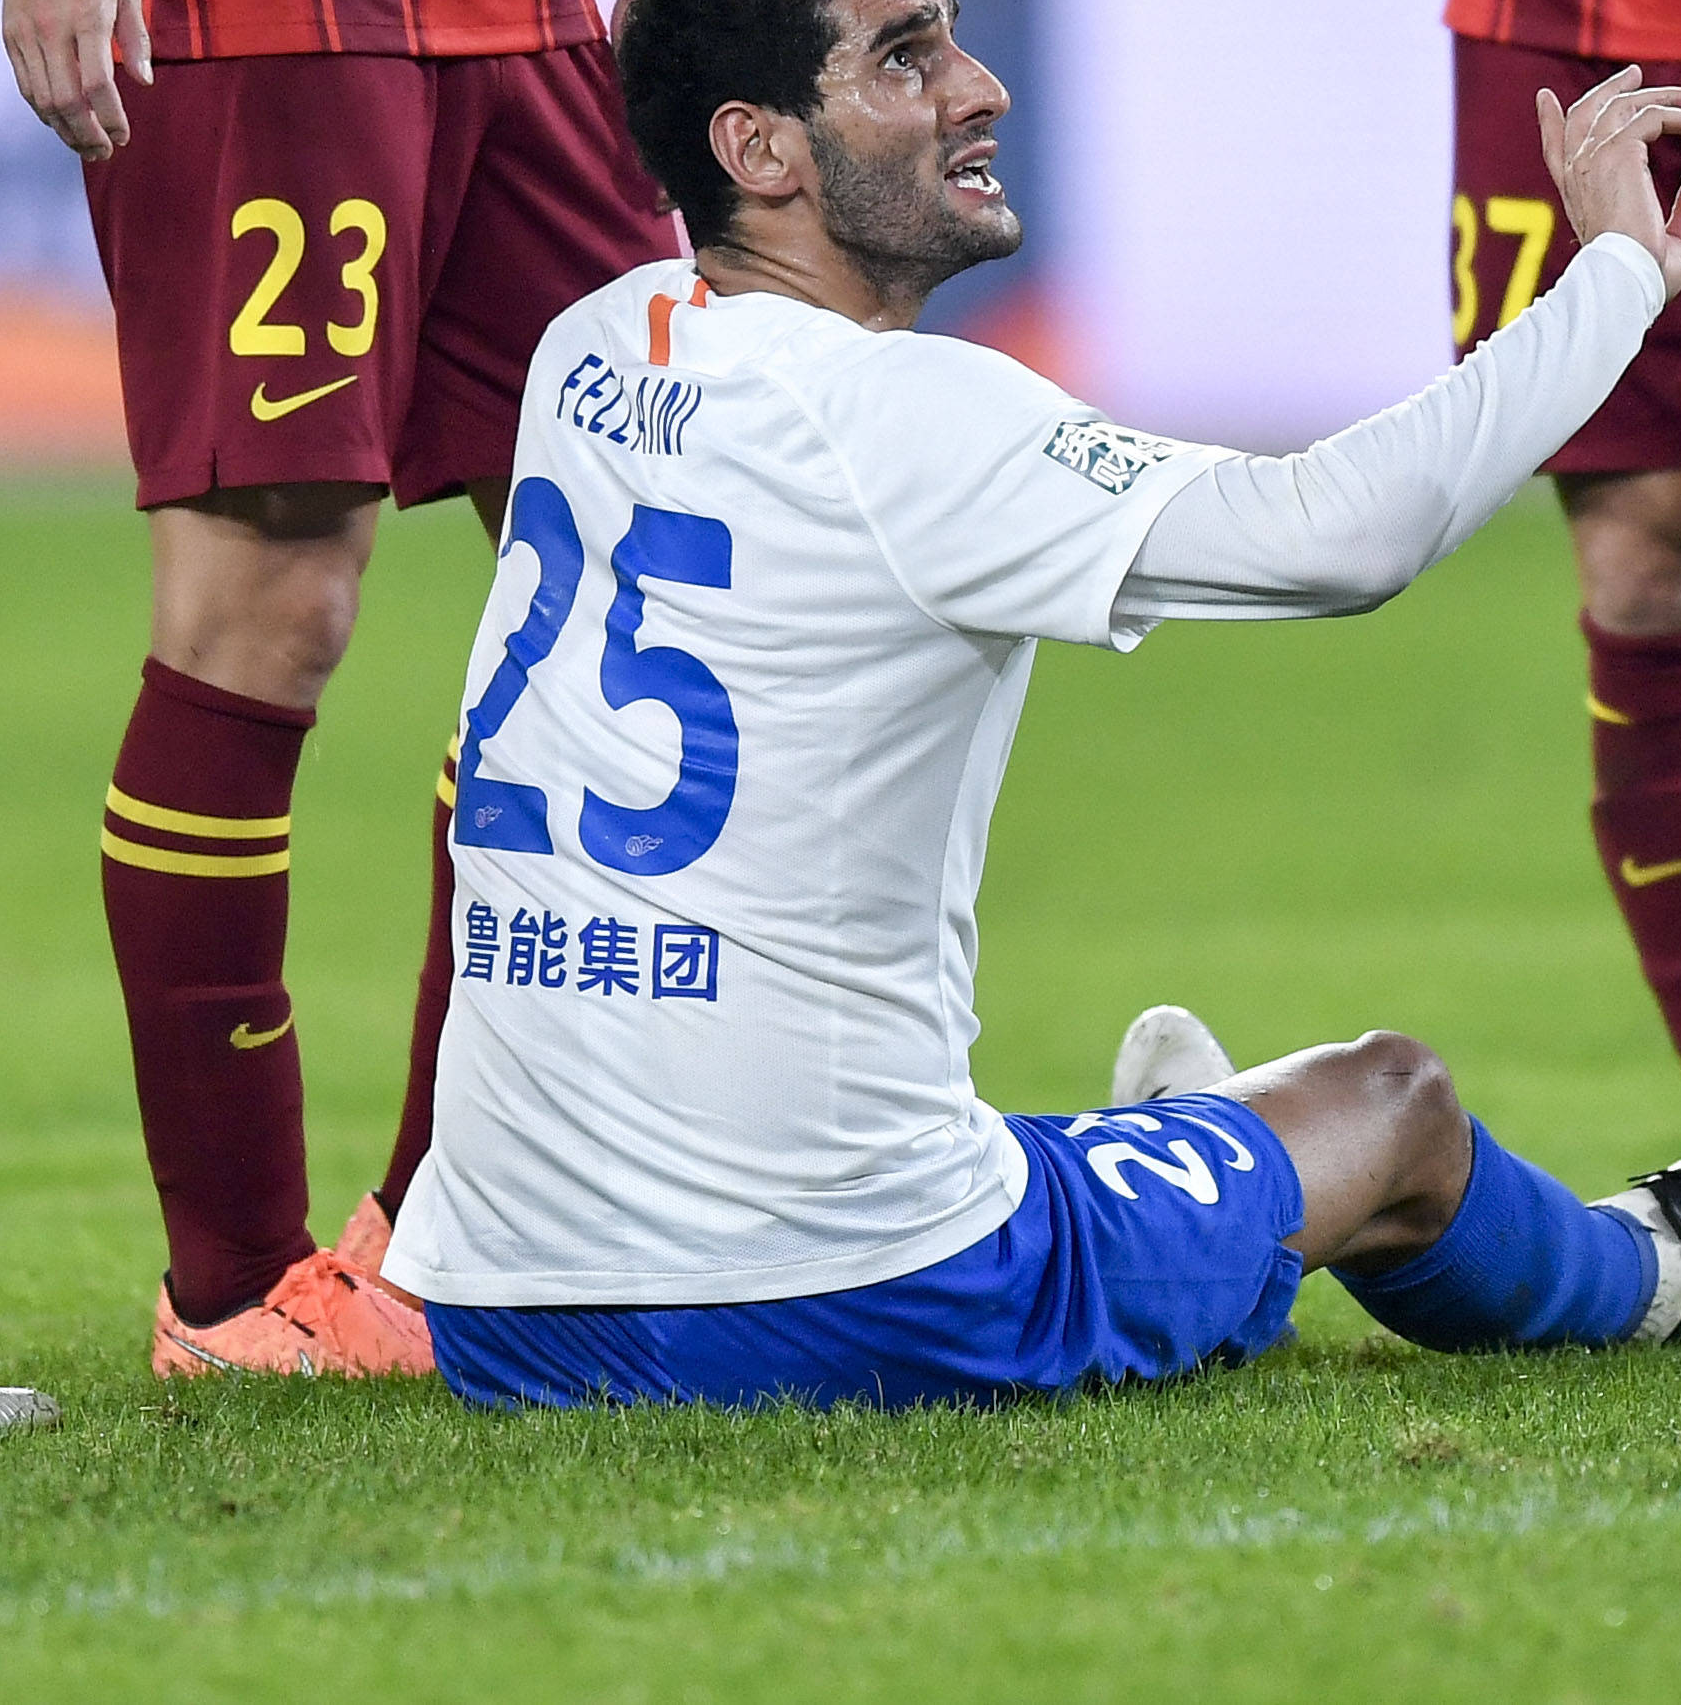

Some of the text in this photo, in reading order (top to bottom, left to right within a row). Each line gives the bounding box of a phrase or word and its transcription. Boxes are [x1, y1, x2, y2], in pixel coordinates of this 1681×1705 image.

[230, 198, 386, 357] 23
[454, 476, 740, 877] 25
[460, 900, 720, 1003] 鲁能集团
